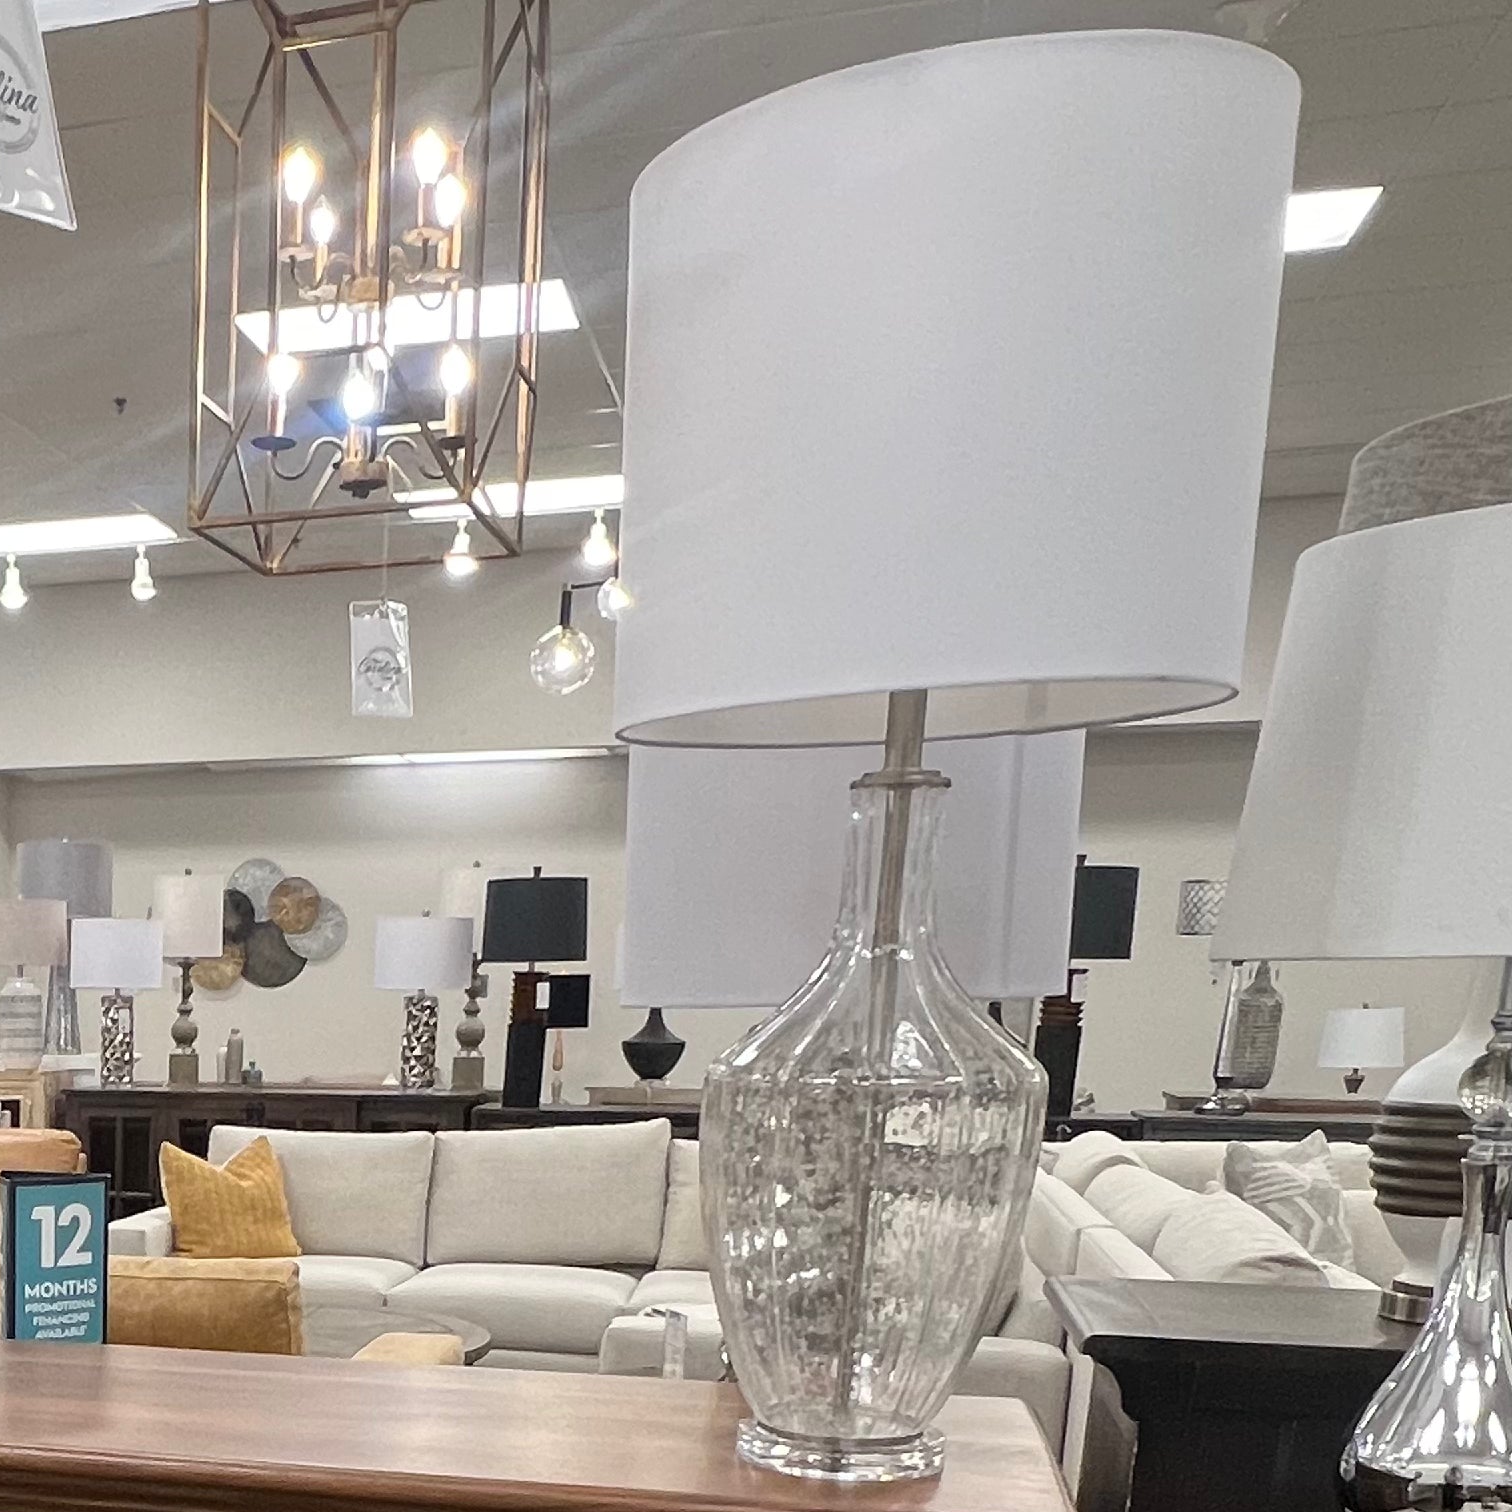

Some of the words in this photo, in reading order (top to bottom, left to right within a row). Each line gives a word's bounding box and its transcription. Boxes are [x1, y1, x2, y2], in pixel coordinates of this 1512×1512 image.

[31, 1203, 93, 1268] 12
[24, 1277, 98, 1299] MONTHS
[24, 1299, 96, 1314] PROMOTIONAL
